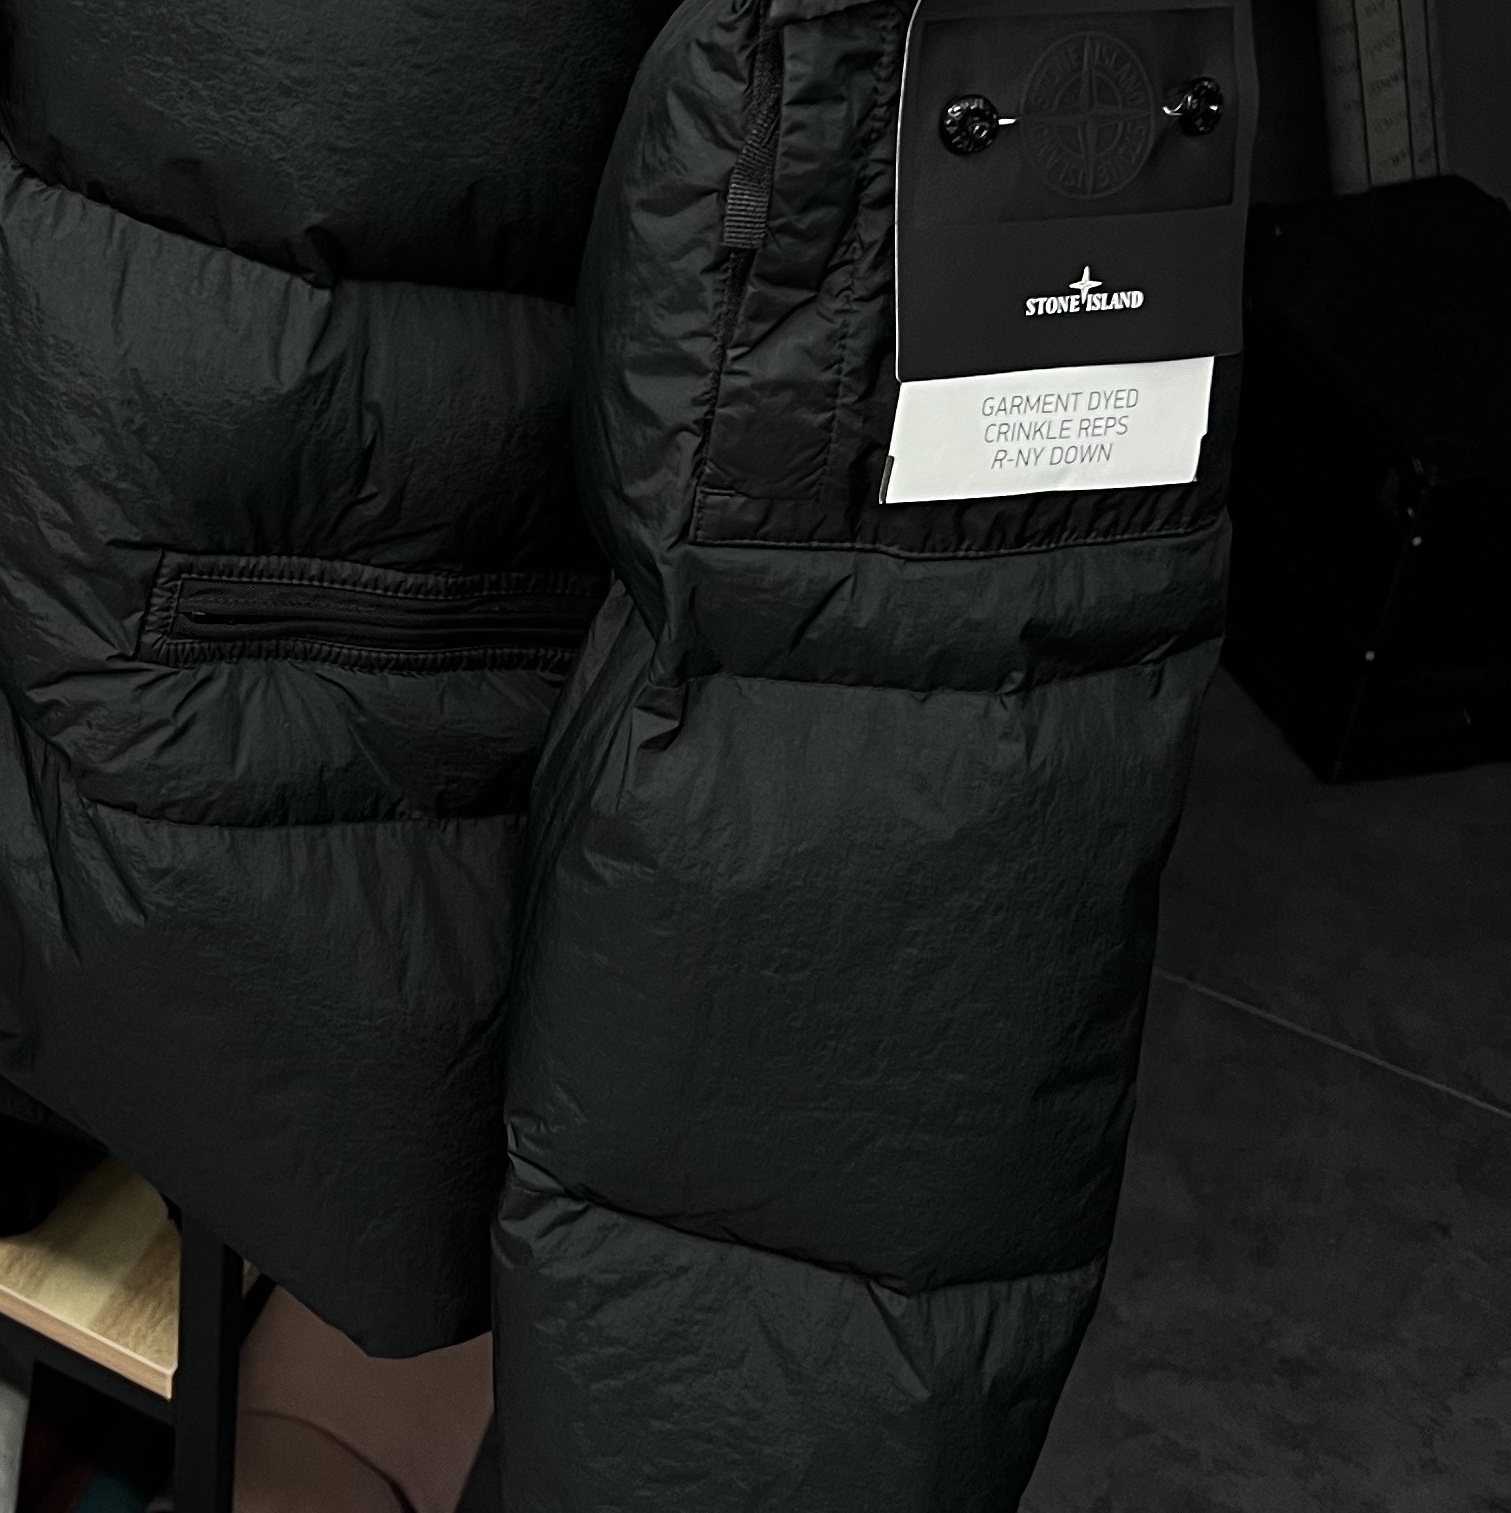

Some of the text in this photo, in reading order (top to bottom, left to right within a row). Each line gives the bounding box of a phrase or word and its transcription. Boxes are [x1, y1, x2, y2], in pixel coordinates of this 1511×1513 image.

[1025, 290, 1144, 316] STONE ISLAND
[981, 388, 1139, 417] GARMENT DYED
[984, 415, 1129, 443] CRINKLE REPS
[991, 443, 1113, 469] R-NY DOWN
